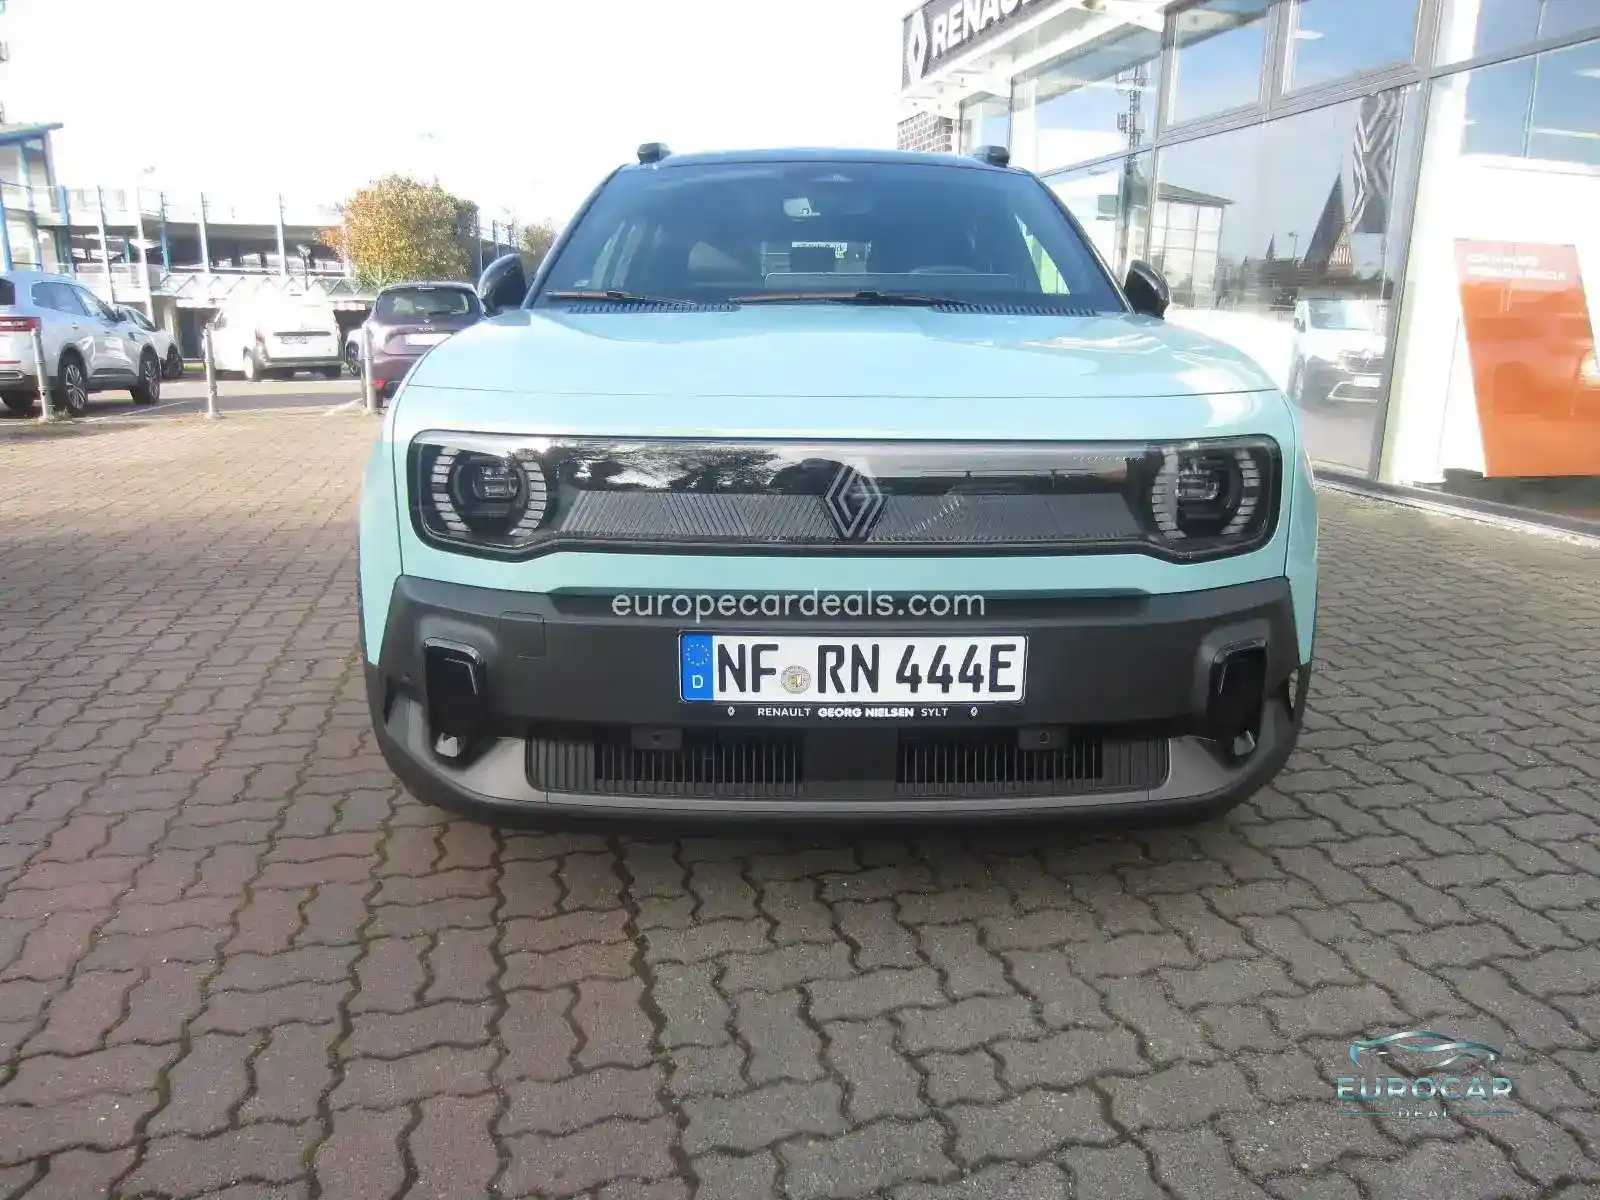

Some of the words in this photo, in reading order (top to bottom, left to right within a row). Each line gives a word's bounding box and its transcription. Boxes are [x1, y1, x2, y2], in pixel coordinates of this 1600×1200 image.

[931, 0, 1030, 58] RENA
[691, 674, 704, 689] D
[717, 643, 779, 693] NF
[817, 644, 880, 693] RN
[895, 643, 1017, 693] 444E
[757, 706, 811, 717] RENAULT
[817, 706, 862, 718] GEORG
[865, 707, 914, 718] NIELSEN
[920, 707, 949, 717] SYLT
